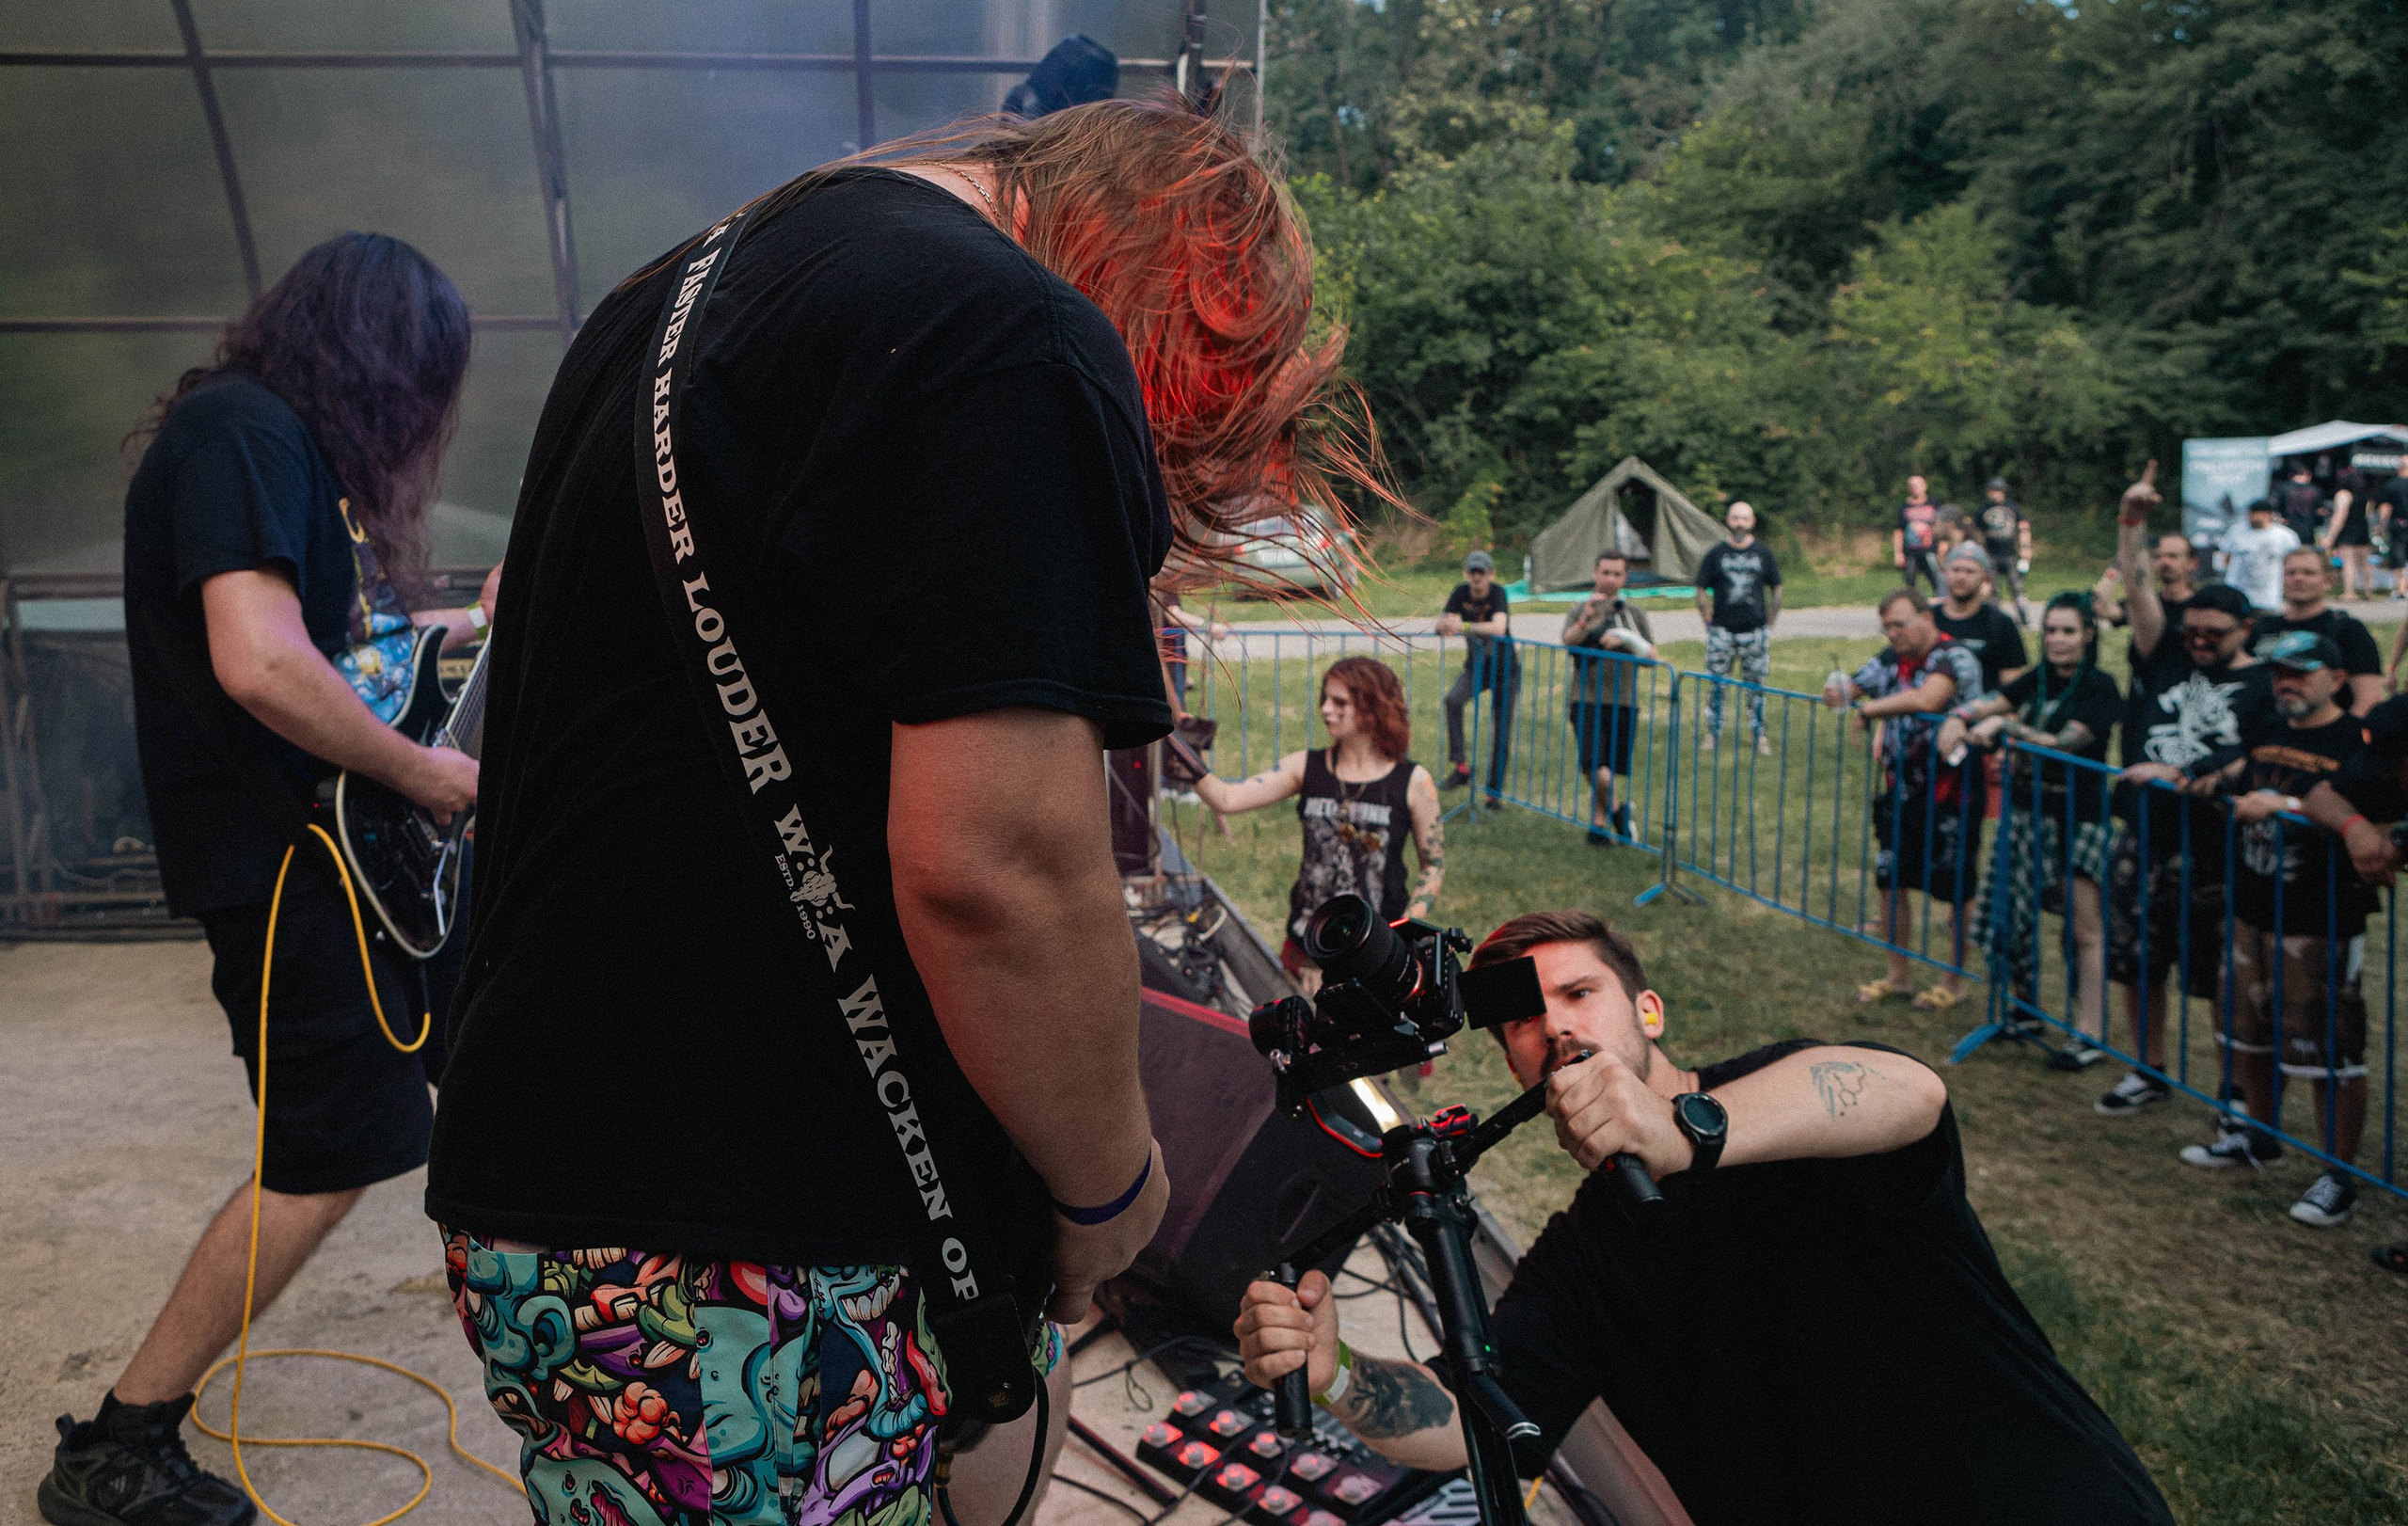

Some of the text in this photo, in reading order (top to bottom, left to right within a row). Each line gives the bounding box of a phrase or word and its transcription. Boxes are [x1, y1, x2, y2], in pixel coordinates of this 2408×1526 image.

[657, 246, 722, 368] FASTER
[653, 367, 695, 564] HARDER
[682, 570, 792, 795] LOUDER
[796, 904, 816, 940] 1990
[837, 974, 954, 1221] WACKEN
